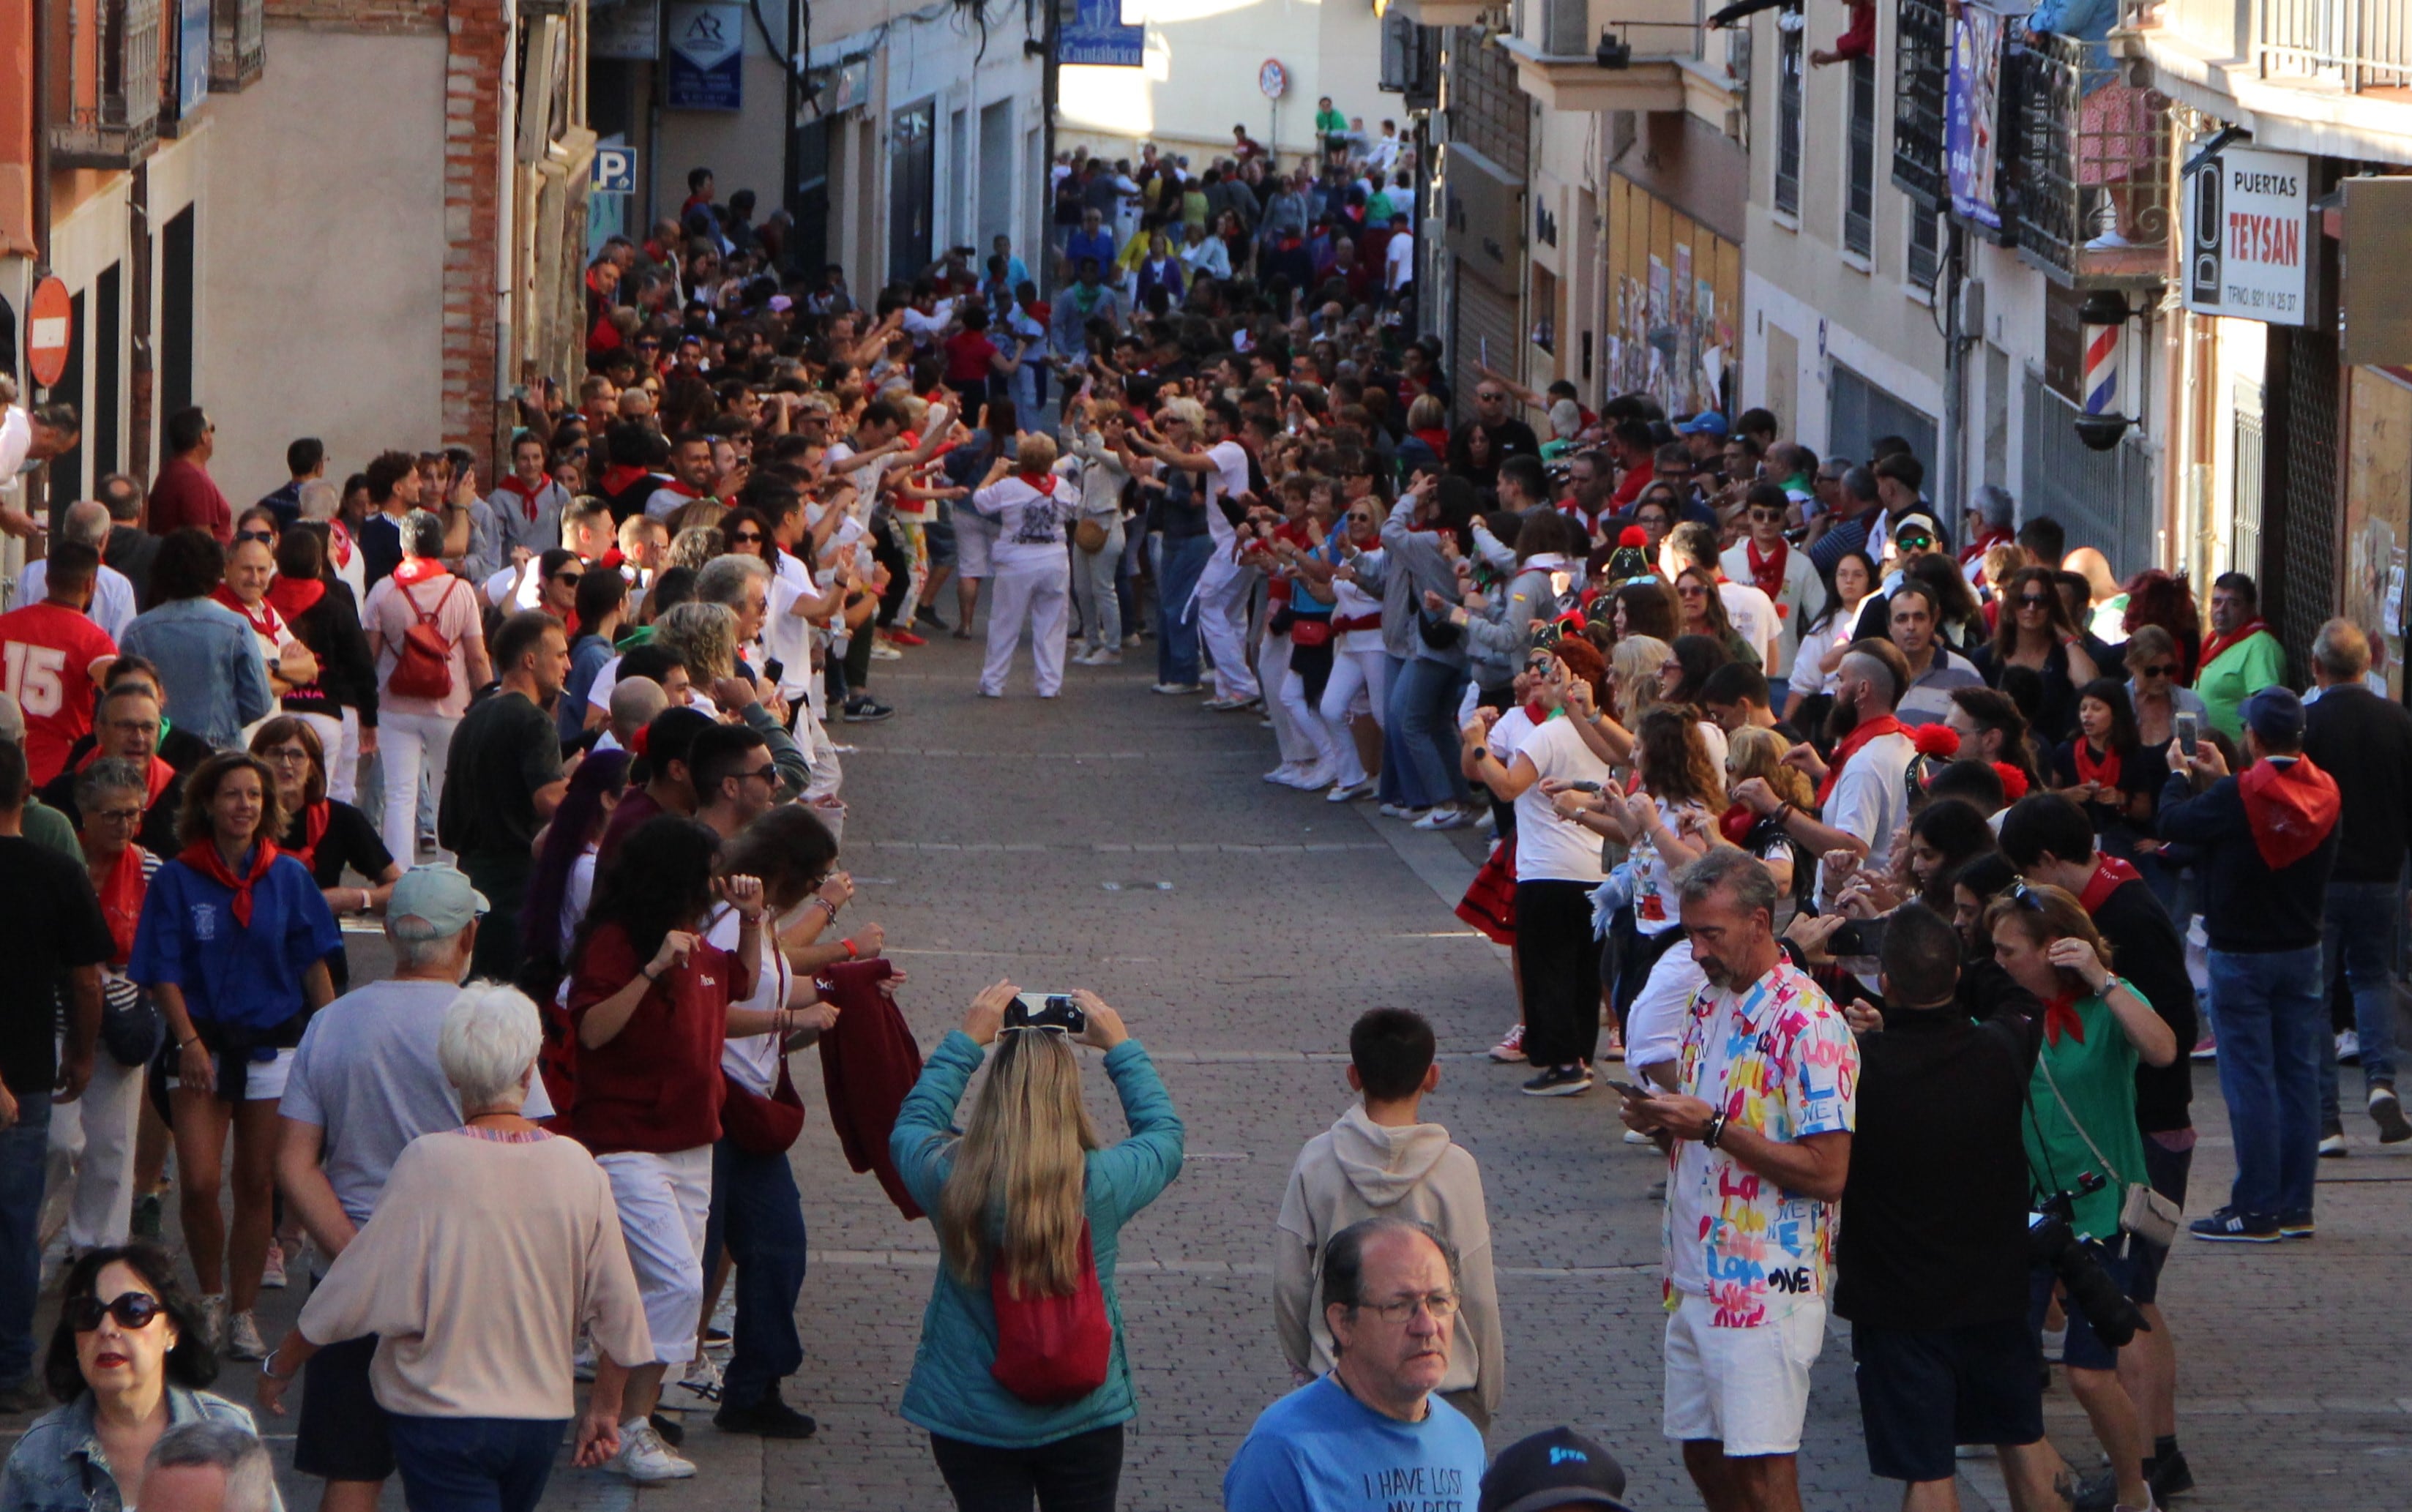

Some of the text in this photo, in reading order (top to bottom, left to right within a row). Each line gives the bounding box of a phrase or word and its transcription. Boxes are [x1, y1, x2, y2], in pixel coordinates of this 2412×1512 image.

[600, 151, 627, 187] P
[2235, 171, 2298, 197] PUERTAS
[2230, 212, 2299, 267] TEYSAN
[3, 640, 66, 718] 15
[1363, 1467, 1463, 1500] I HAVE LOST
